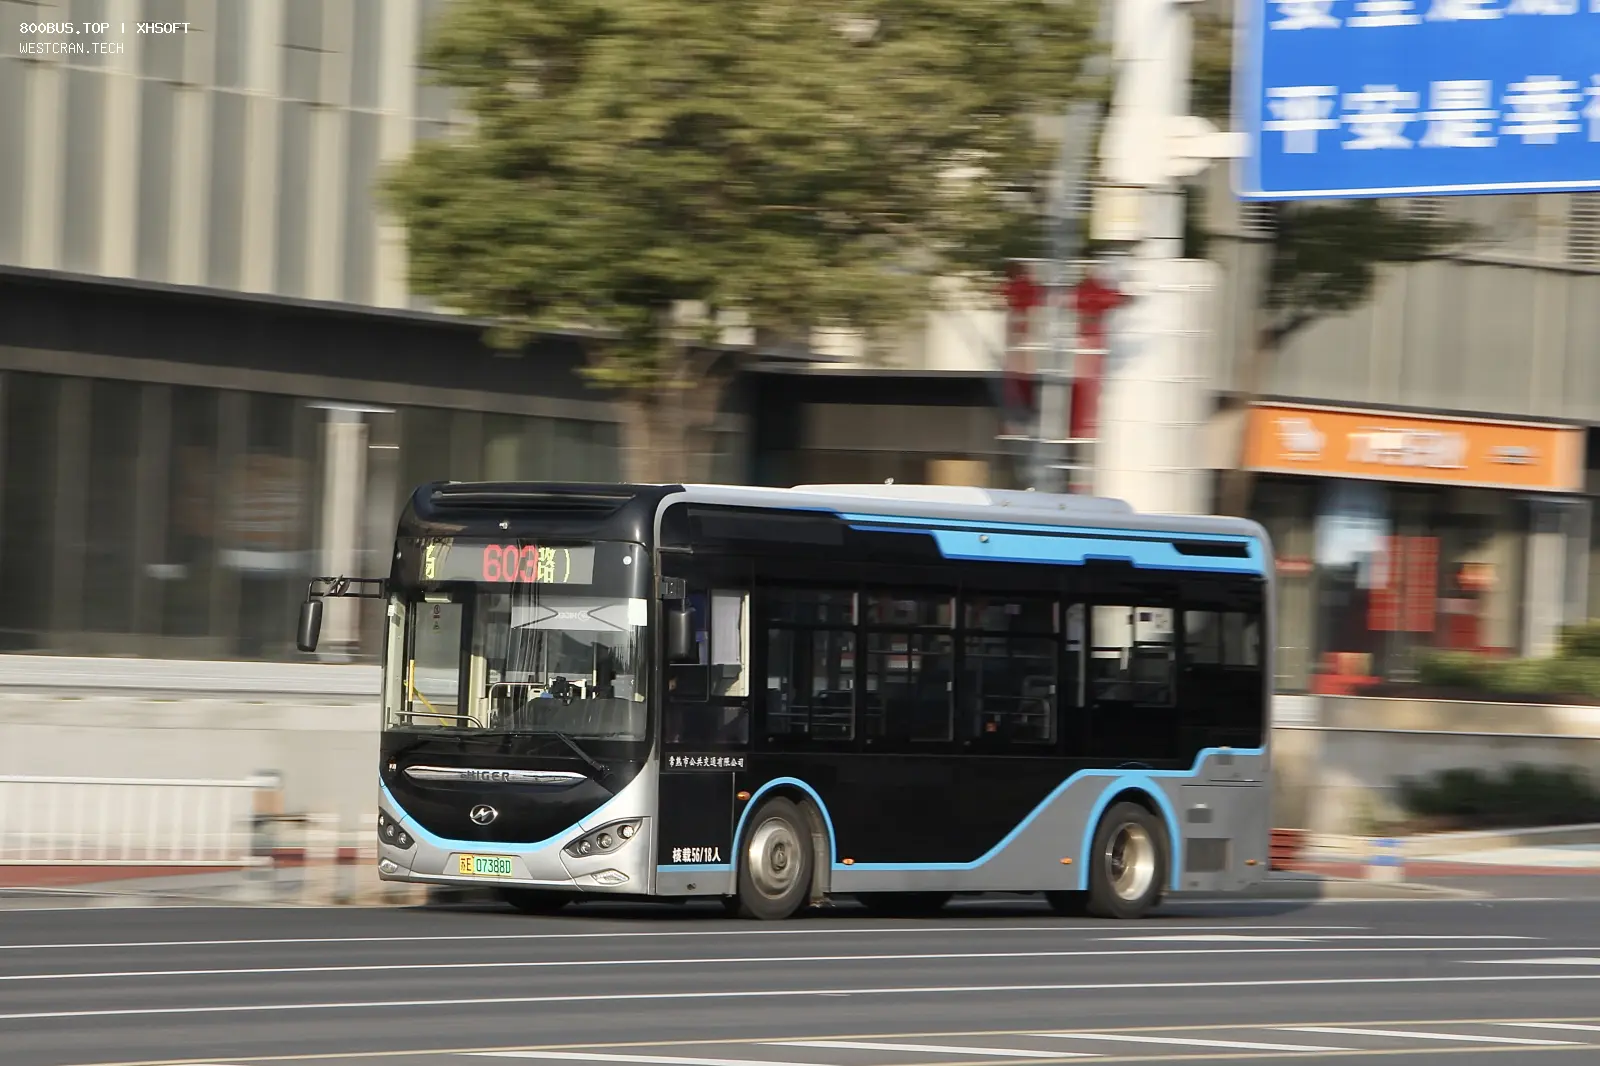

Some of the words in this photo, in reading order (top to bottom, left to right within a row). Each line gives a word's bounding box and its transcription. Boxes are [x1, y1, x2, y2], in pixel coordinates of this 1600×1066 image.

[1262, 74, 1600, 154] 平安是幸
[668, 756, 744, 768] 常熟市公共交通有限公司
[672, 847, 722, 863] 核载56/18人
